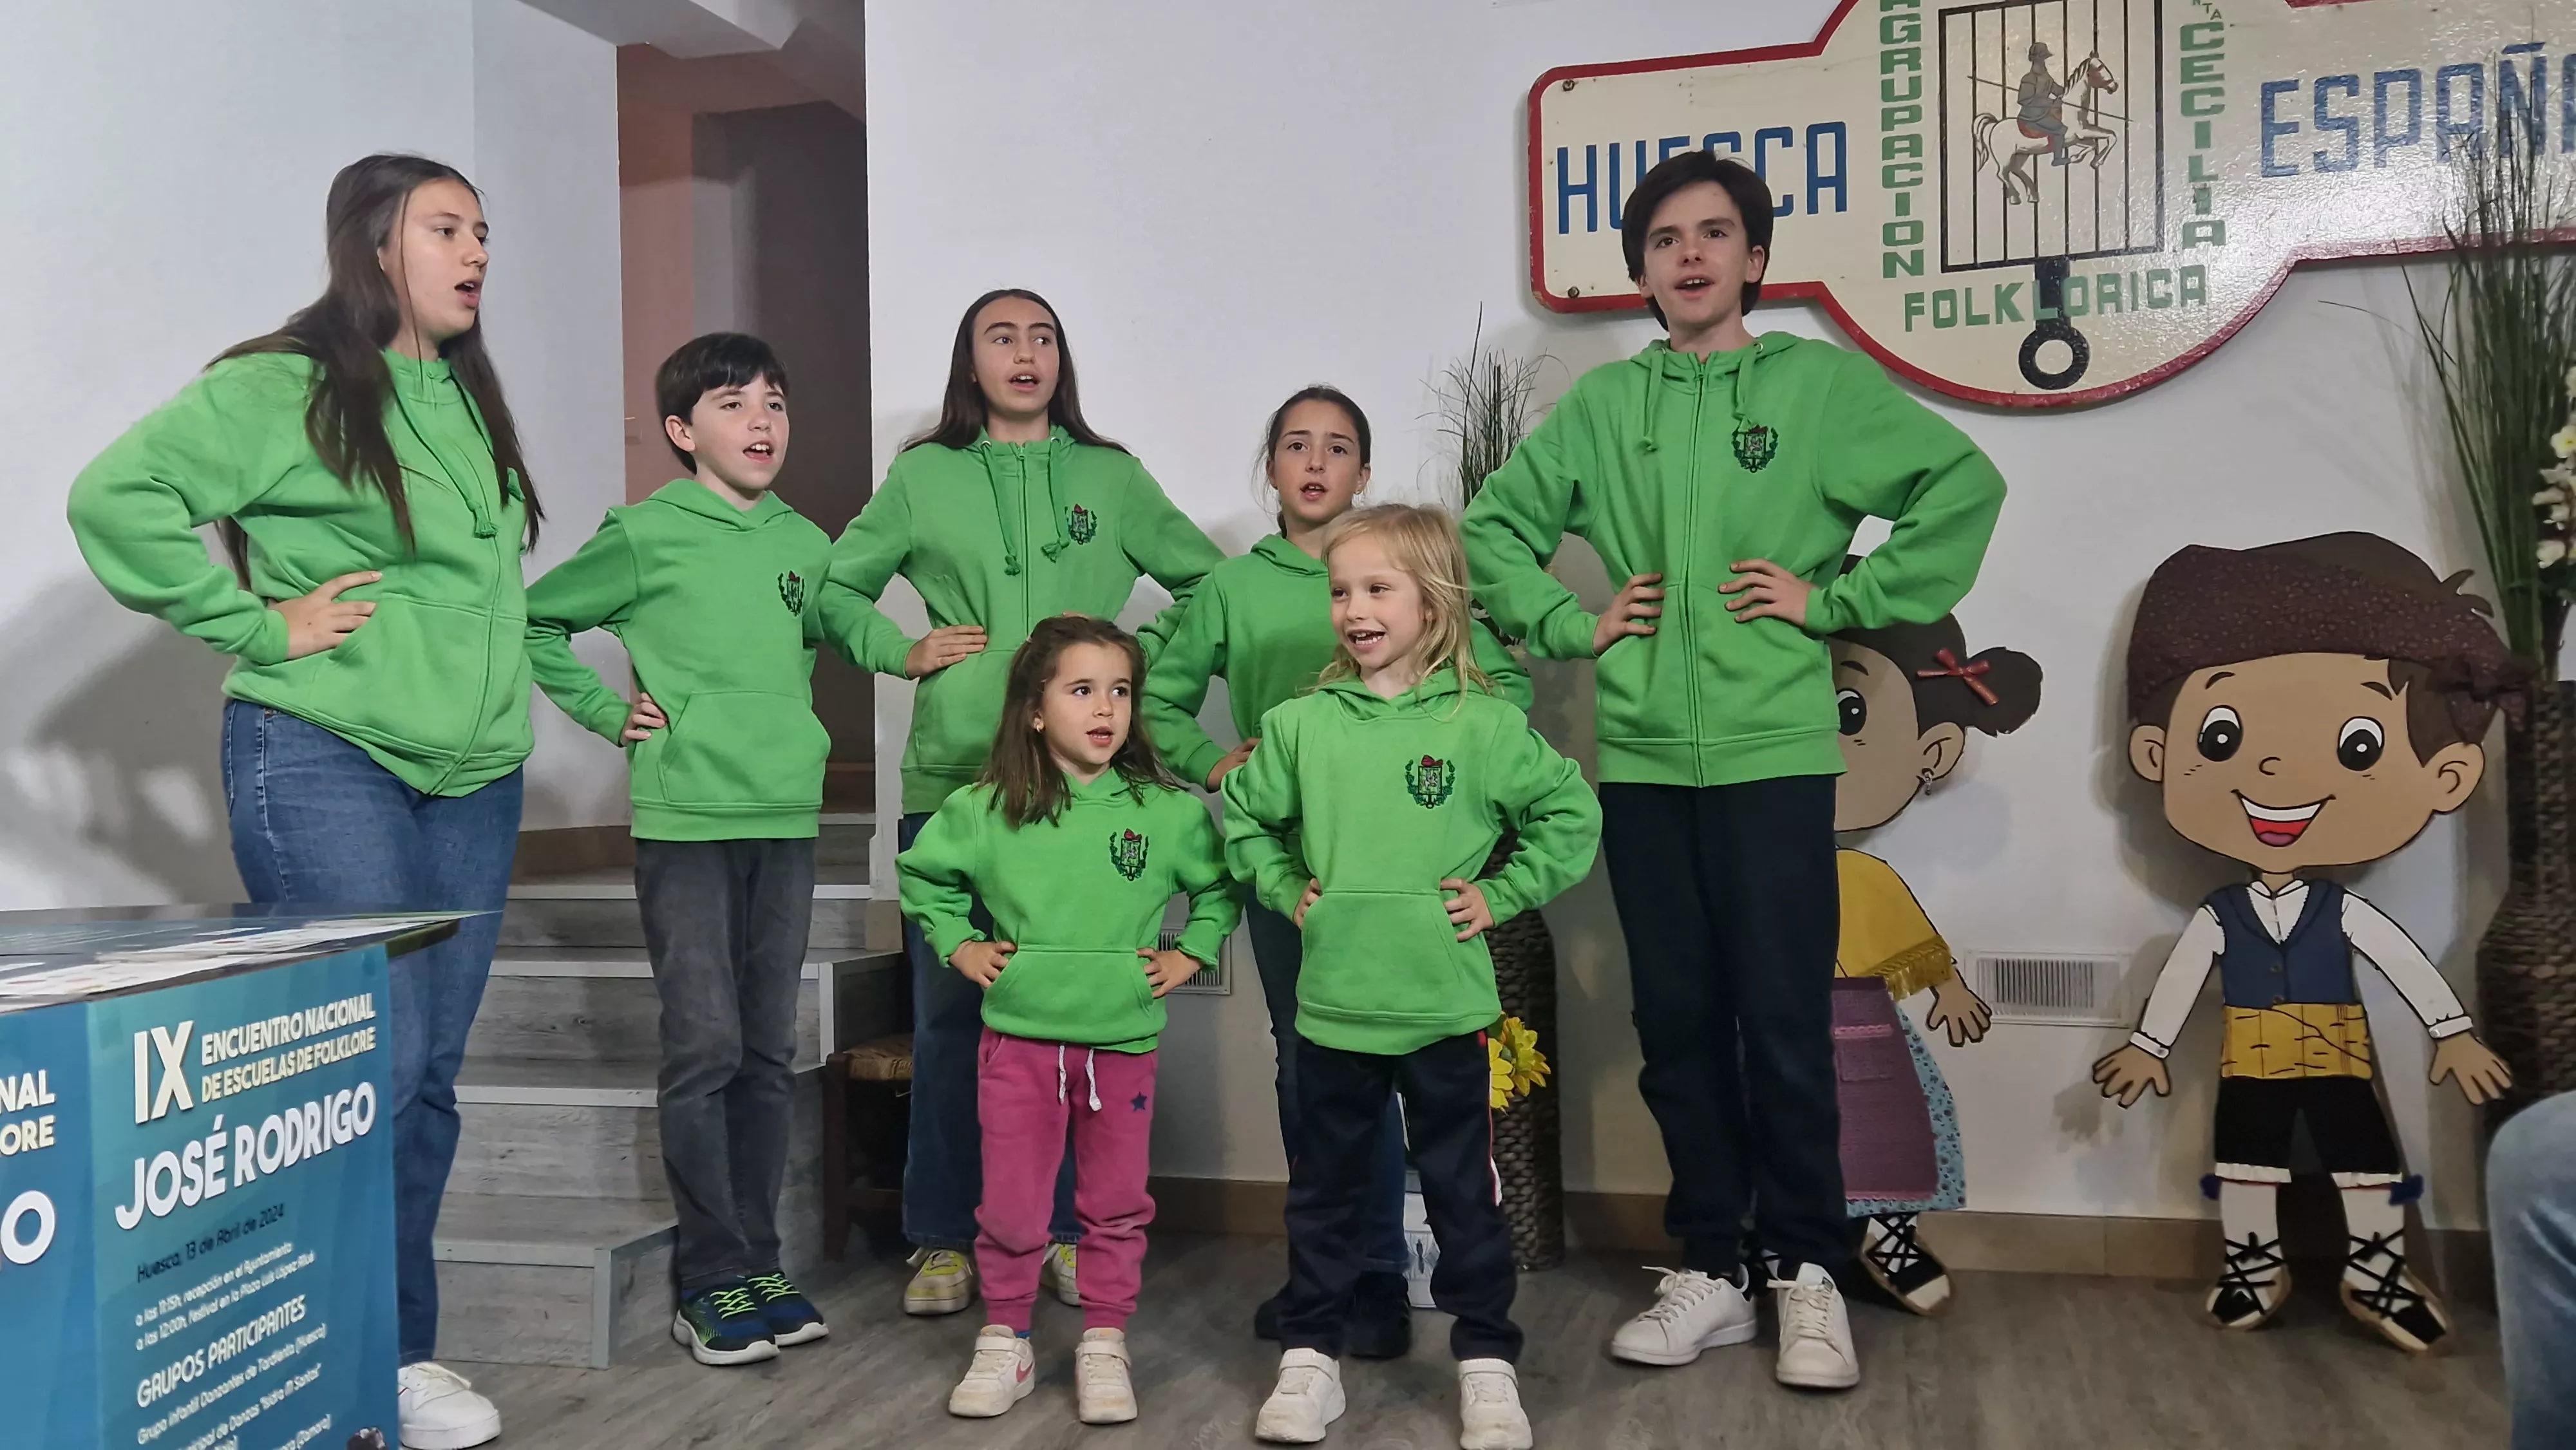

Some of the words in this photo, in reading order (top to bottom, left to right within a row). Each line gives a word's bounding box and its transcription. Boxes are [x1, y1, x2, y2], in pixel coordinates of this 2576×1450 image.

[1557, 121, 1847, 234] HUCA
[2180, 21, 2226, 249] CECILIA
[1904, 264, 2207, 332] FOLKLORICA
[134, 1020, 194, 1125] IX
[202, 1012, 303, 1066] ENCUENTRO
[305, 992, 375, 1037] NACIONAL
[202, 1071, 222, 1103] DE
[223, 1051, 296, 1098] ESCUELAS
[296, 1045, 316, 1073] DE
[314, 1026, 376, 1067] FOLKLORE
[115, 1114, 227, 1230] JOSÉ
[234, 1082, 375, 1187] RODRIGO
[186, 1241, 196, 1259] 13
[199, 1238, 214, 1254] de
[216, 1223, 241, 1247] Abril
[242, 1218, 257, 1235] de
[259, 1203, 285, 1228] 2024
[137, 1348, 205, 1408] GRUPOS
[207, 1294, 306, 1370] PARTICIPANTES
